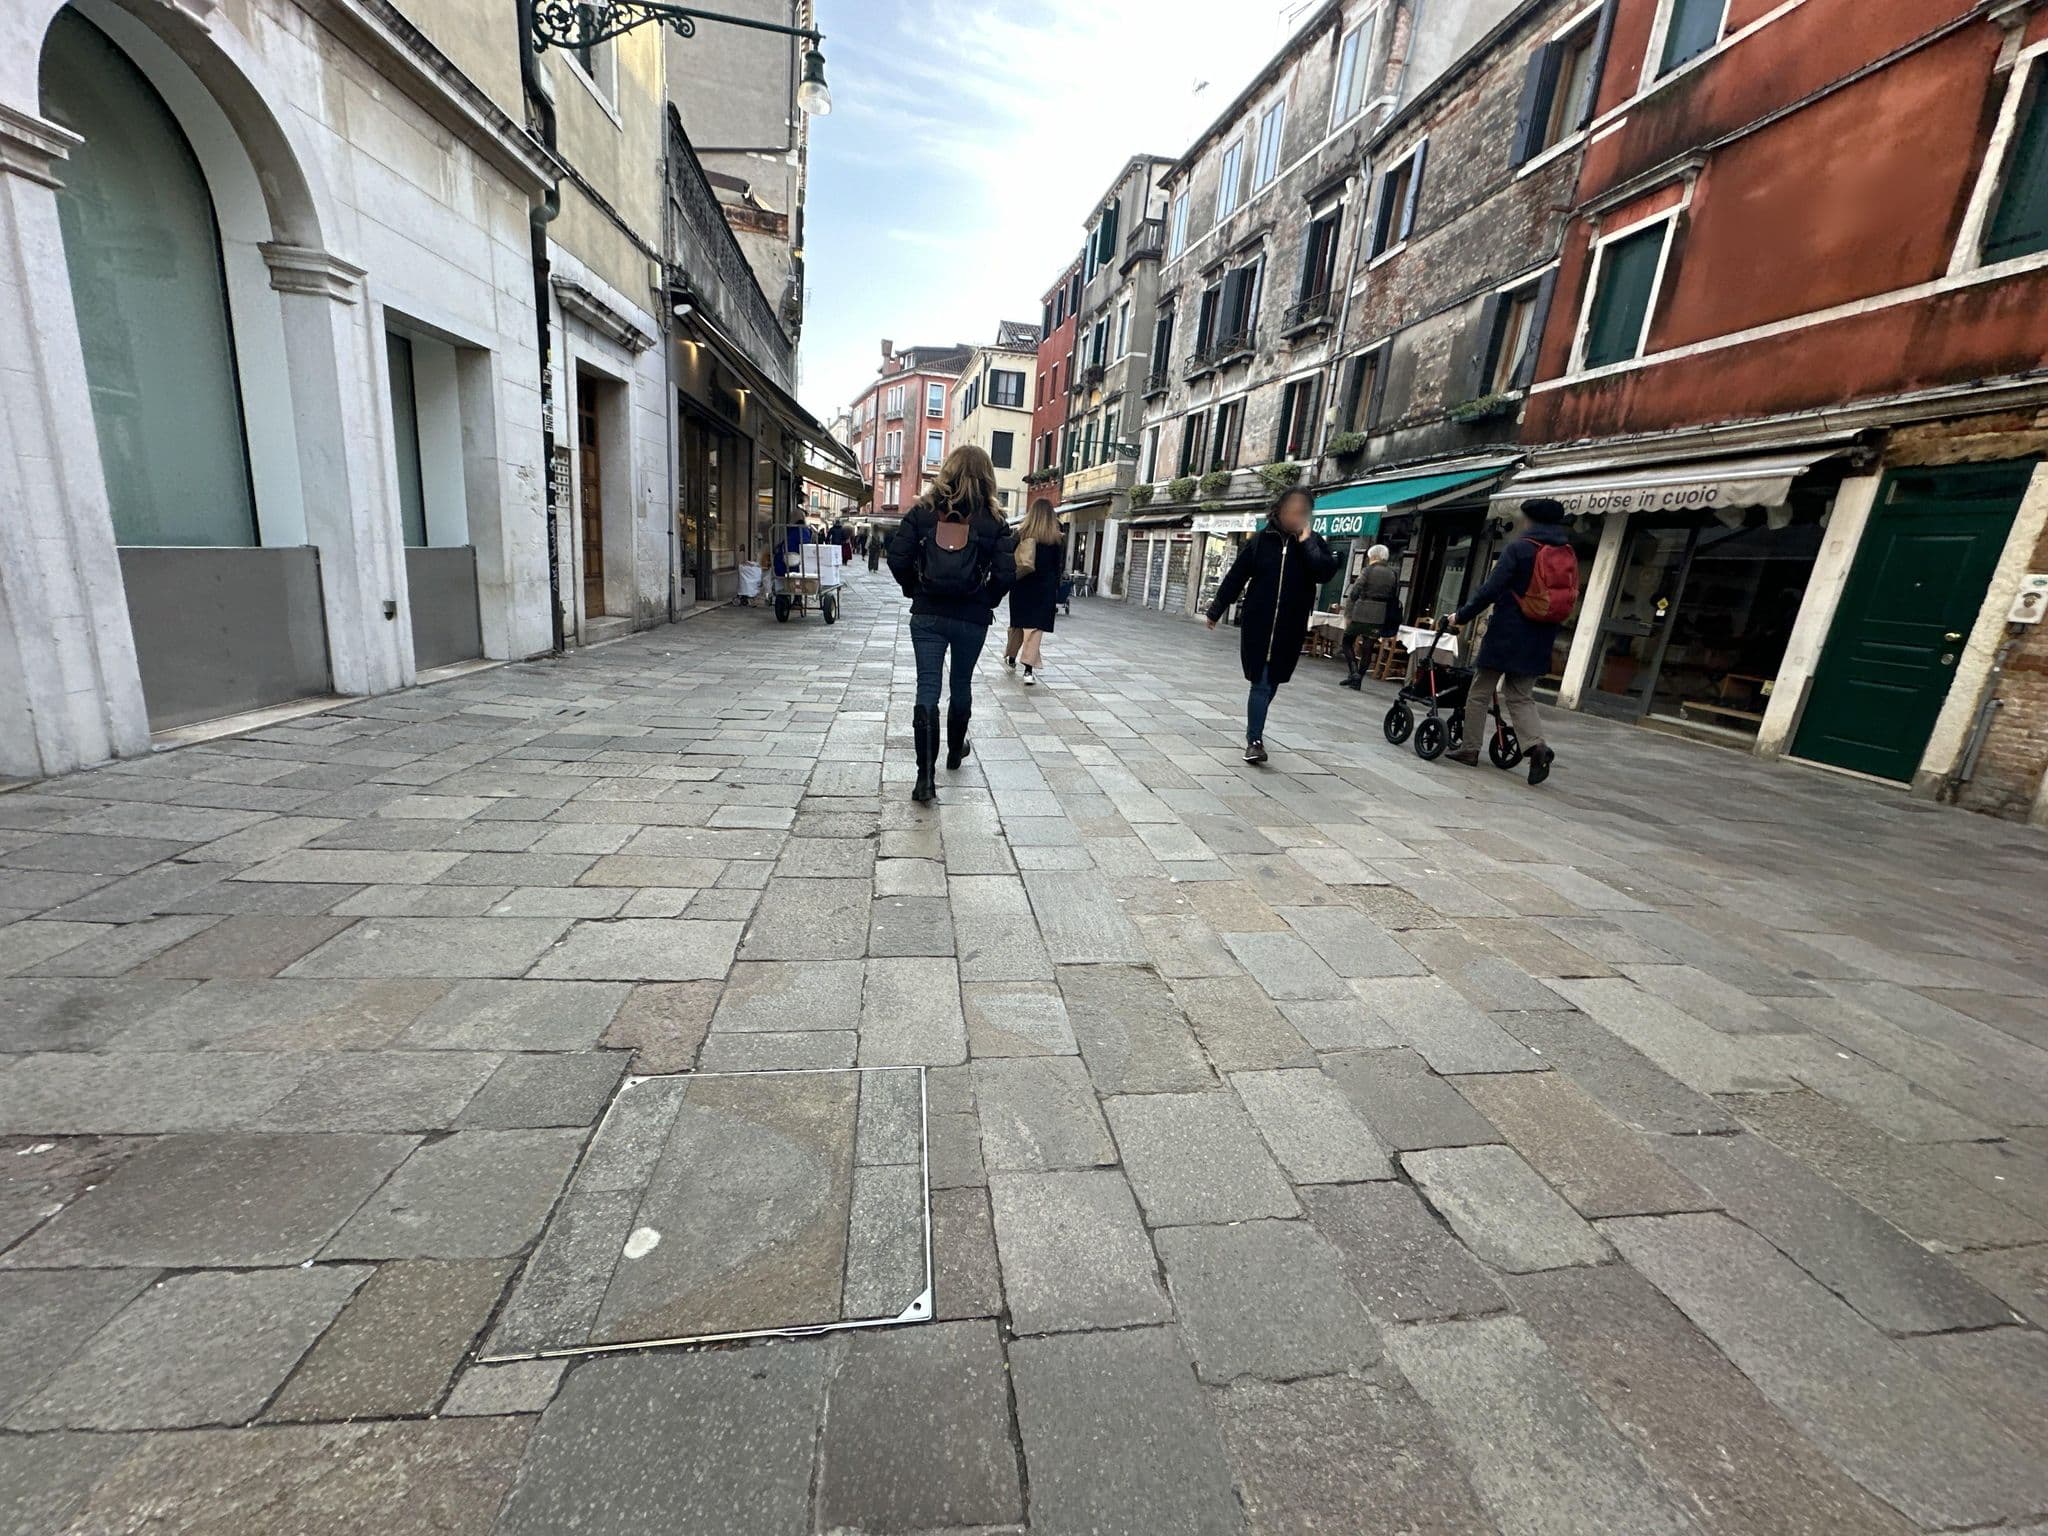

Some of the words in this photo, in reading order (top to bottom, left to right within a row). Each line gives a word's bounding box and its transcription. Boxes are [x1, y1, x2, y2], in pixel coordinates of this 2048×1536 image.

[1588, 495, 1632, 510] borse
[1638, 490, 1655, 507] in
[1662, 486, 1718, 505] cuoio
[1313, 518, 1327, 532] DA
[1331, 517, 1363, 533] GIGIO
